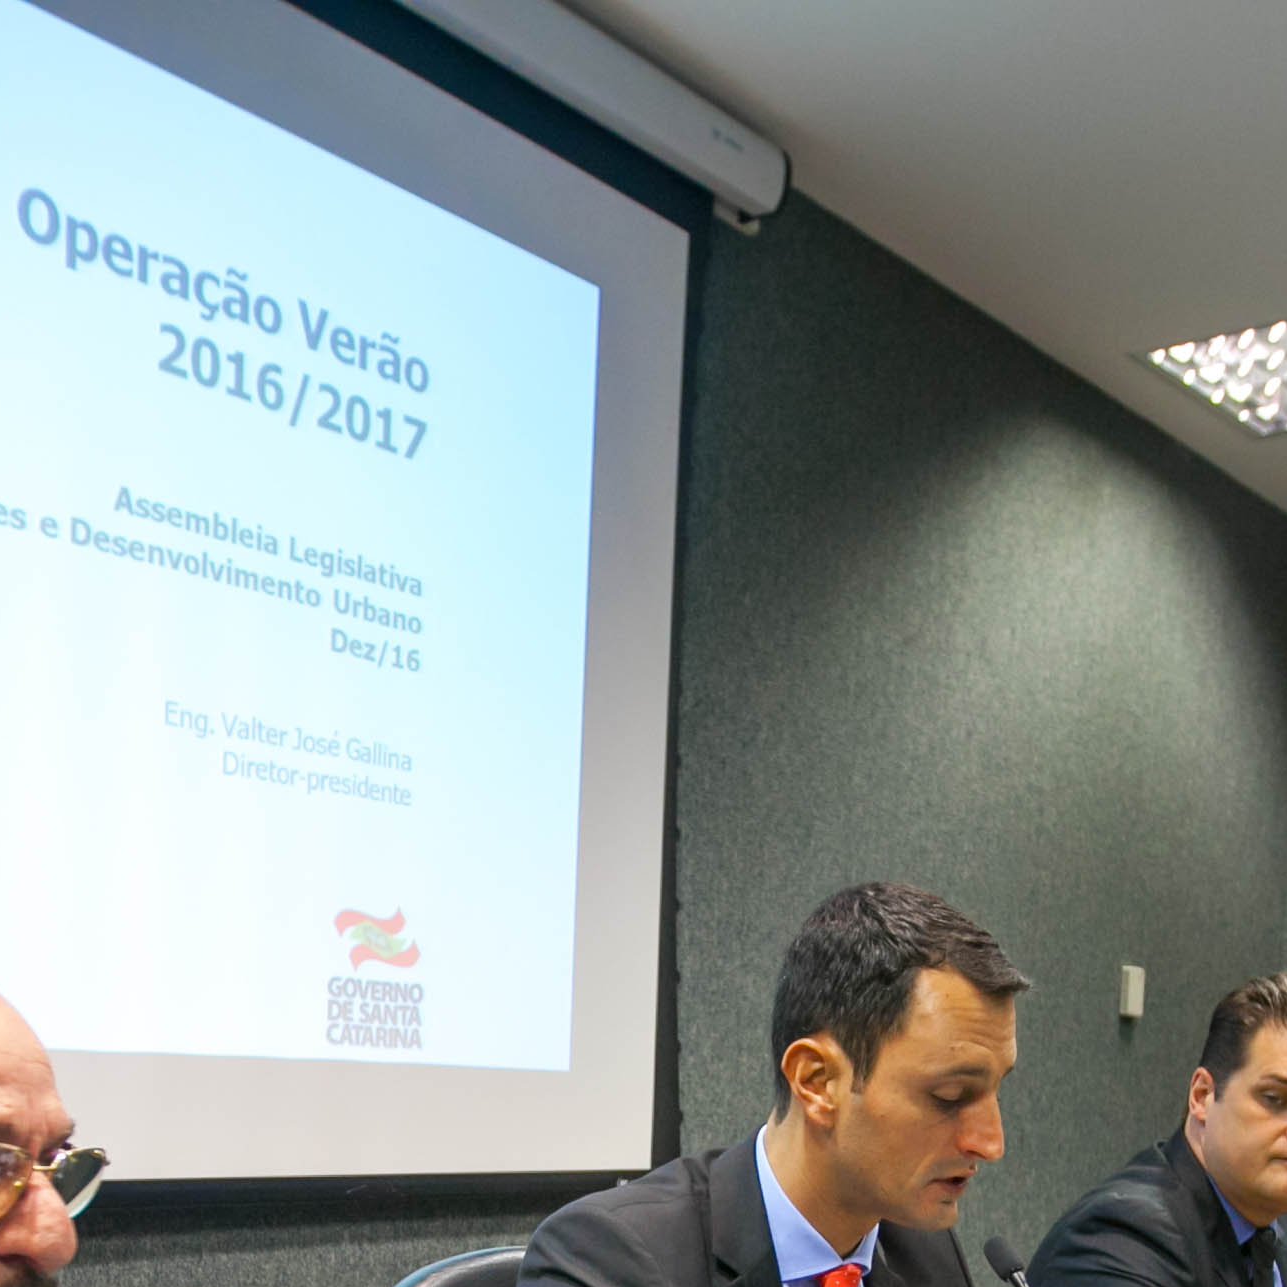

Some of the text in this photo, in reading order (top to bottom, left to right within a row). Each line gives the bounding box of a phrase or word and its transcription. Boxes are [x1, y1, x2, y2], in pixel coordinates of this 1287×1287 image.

[17, 187, 431, 394] Operação Verão
[157, 323, 428, 460] 2016/2017
[114, 486, 423, 597] Assembleia Legislativa
[39, 516, 59, 538] e
[70, 517, 321, 608] Desenvolvimento
[333, 589, 423, 635] Urbano
[330, 628, 421, 672] Dez/16
[164, 700, 412, 772] Eng. Valter José Gallina
[223, 751, 412, 807] Diretor-presidente
[328, 977, 423, 1003] GOVERNO
[328, 1000, 422, 1025] DE SANTA
[327, 1024, 421, 1048] CATARINA
